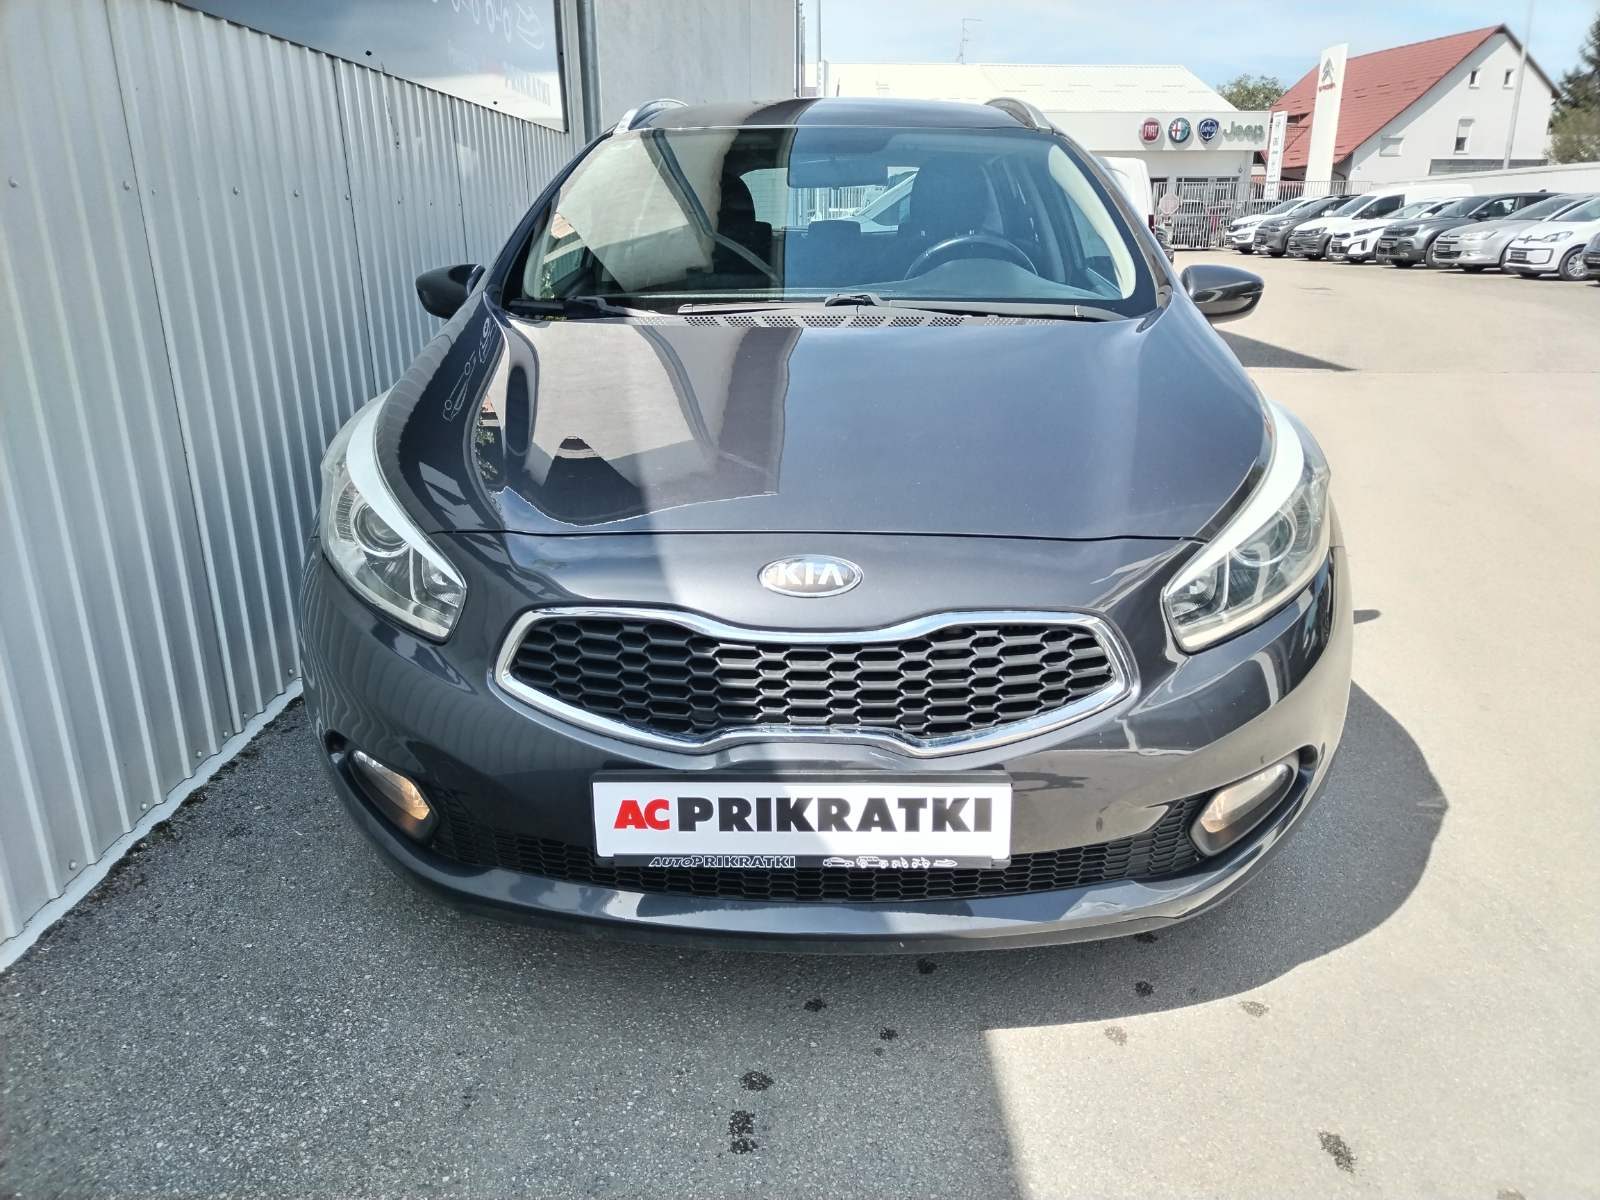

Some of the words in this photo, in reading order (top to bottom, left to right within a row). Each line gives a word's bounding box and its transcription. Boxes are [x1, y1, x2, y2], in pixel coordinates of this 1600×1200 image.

[1144, 124, 1160, 137] FIAT
[1223, 120, 1265, 143] Jeep
[776, 562, 844, 586] KIA
[648, 855, 796, 869] AUTOPRIKRATKI
